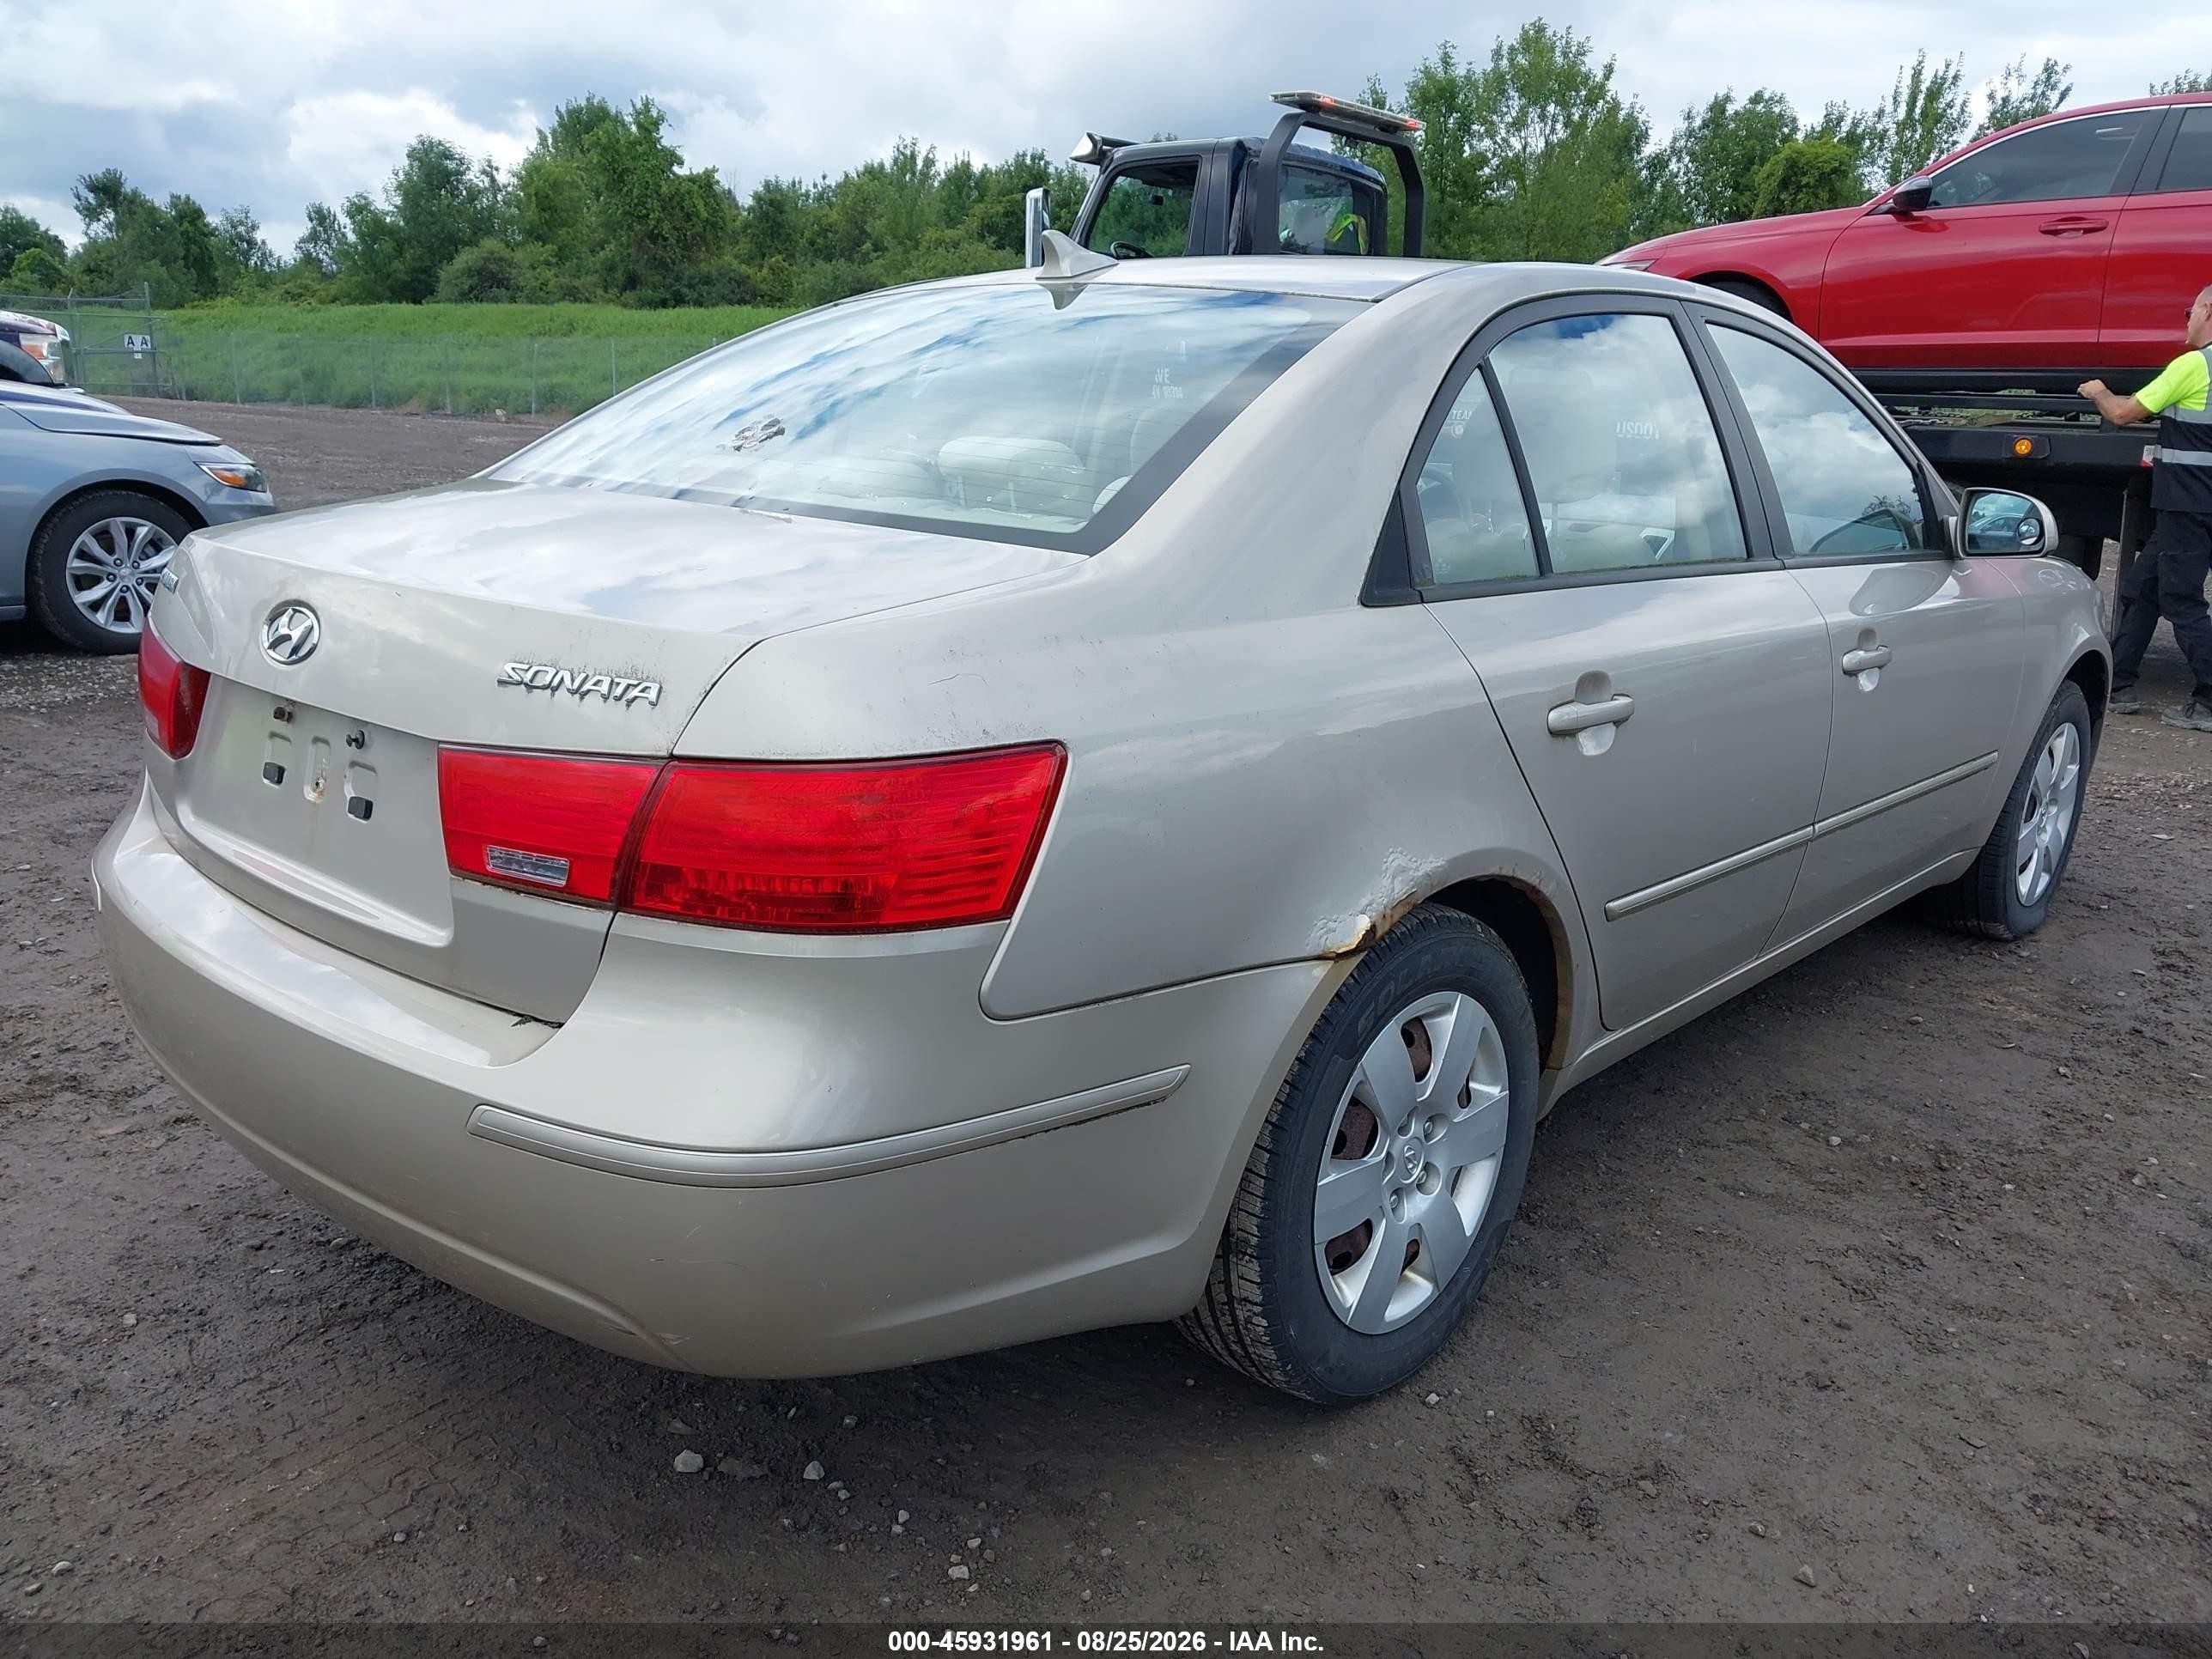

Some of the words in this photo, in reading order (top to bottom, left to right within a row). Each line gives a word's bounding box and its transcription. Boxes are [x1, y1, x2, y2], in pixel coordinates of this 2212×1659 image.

[127, 336, 135, 346] A
[140, 336, 149, 347] A
[496, 661, 663, 707] SONATA
